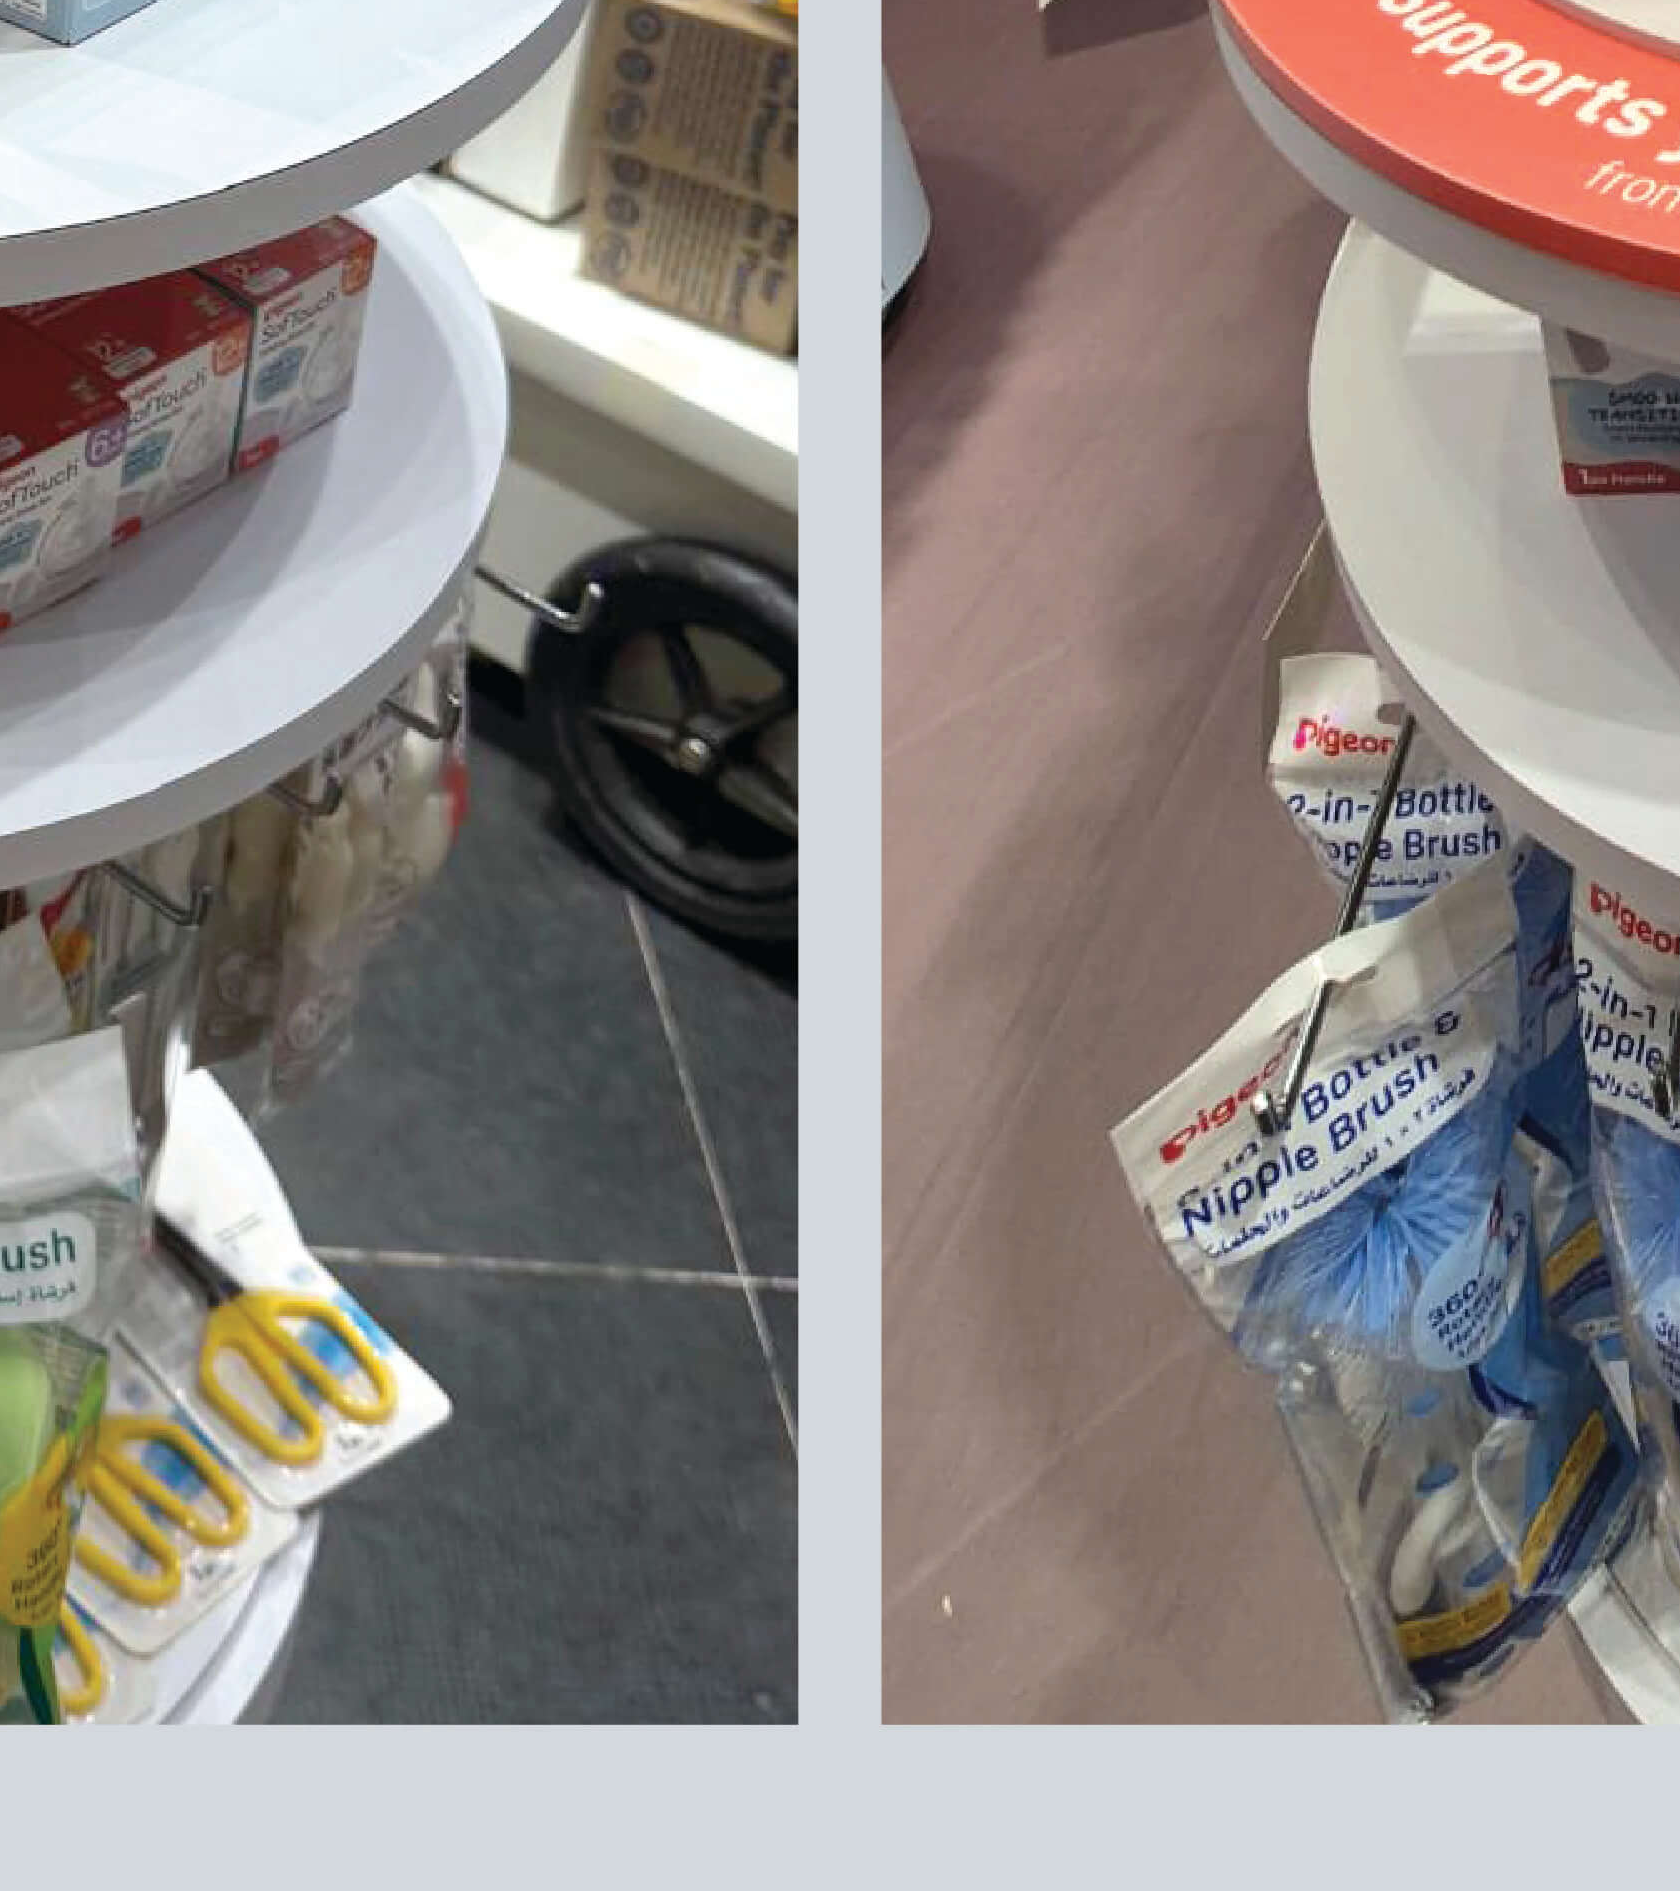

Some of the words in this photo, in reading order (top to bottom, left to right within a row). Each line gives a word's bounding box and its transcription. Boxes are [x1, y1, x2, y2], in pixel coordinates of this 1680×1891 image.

[1286, 785, 1381, 824] 2-in-
[1395, 781, 1496, 819] Bottle
[1403, 822, 1502, 861] Brush
[1582, 1007, 1665, 1076] ipple
[1301, 1033, 1422, 1125] Bottle
[1180, 1143, 1320, 1238] Nipple
[1326, 1050, 1441, 1155] Brush
